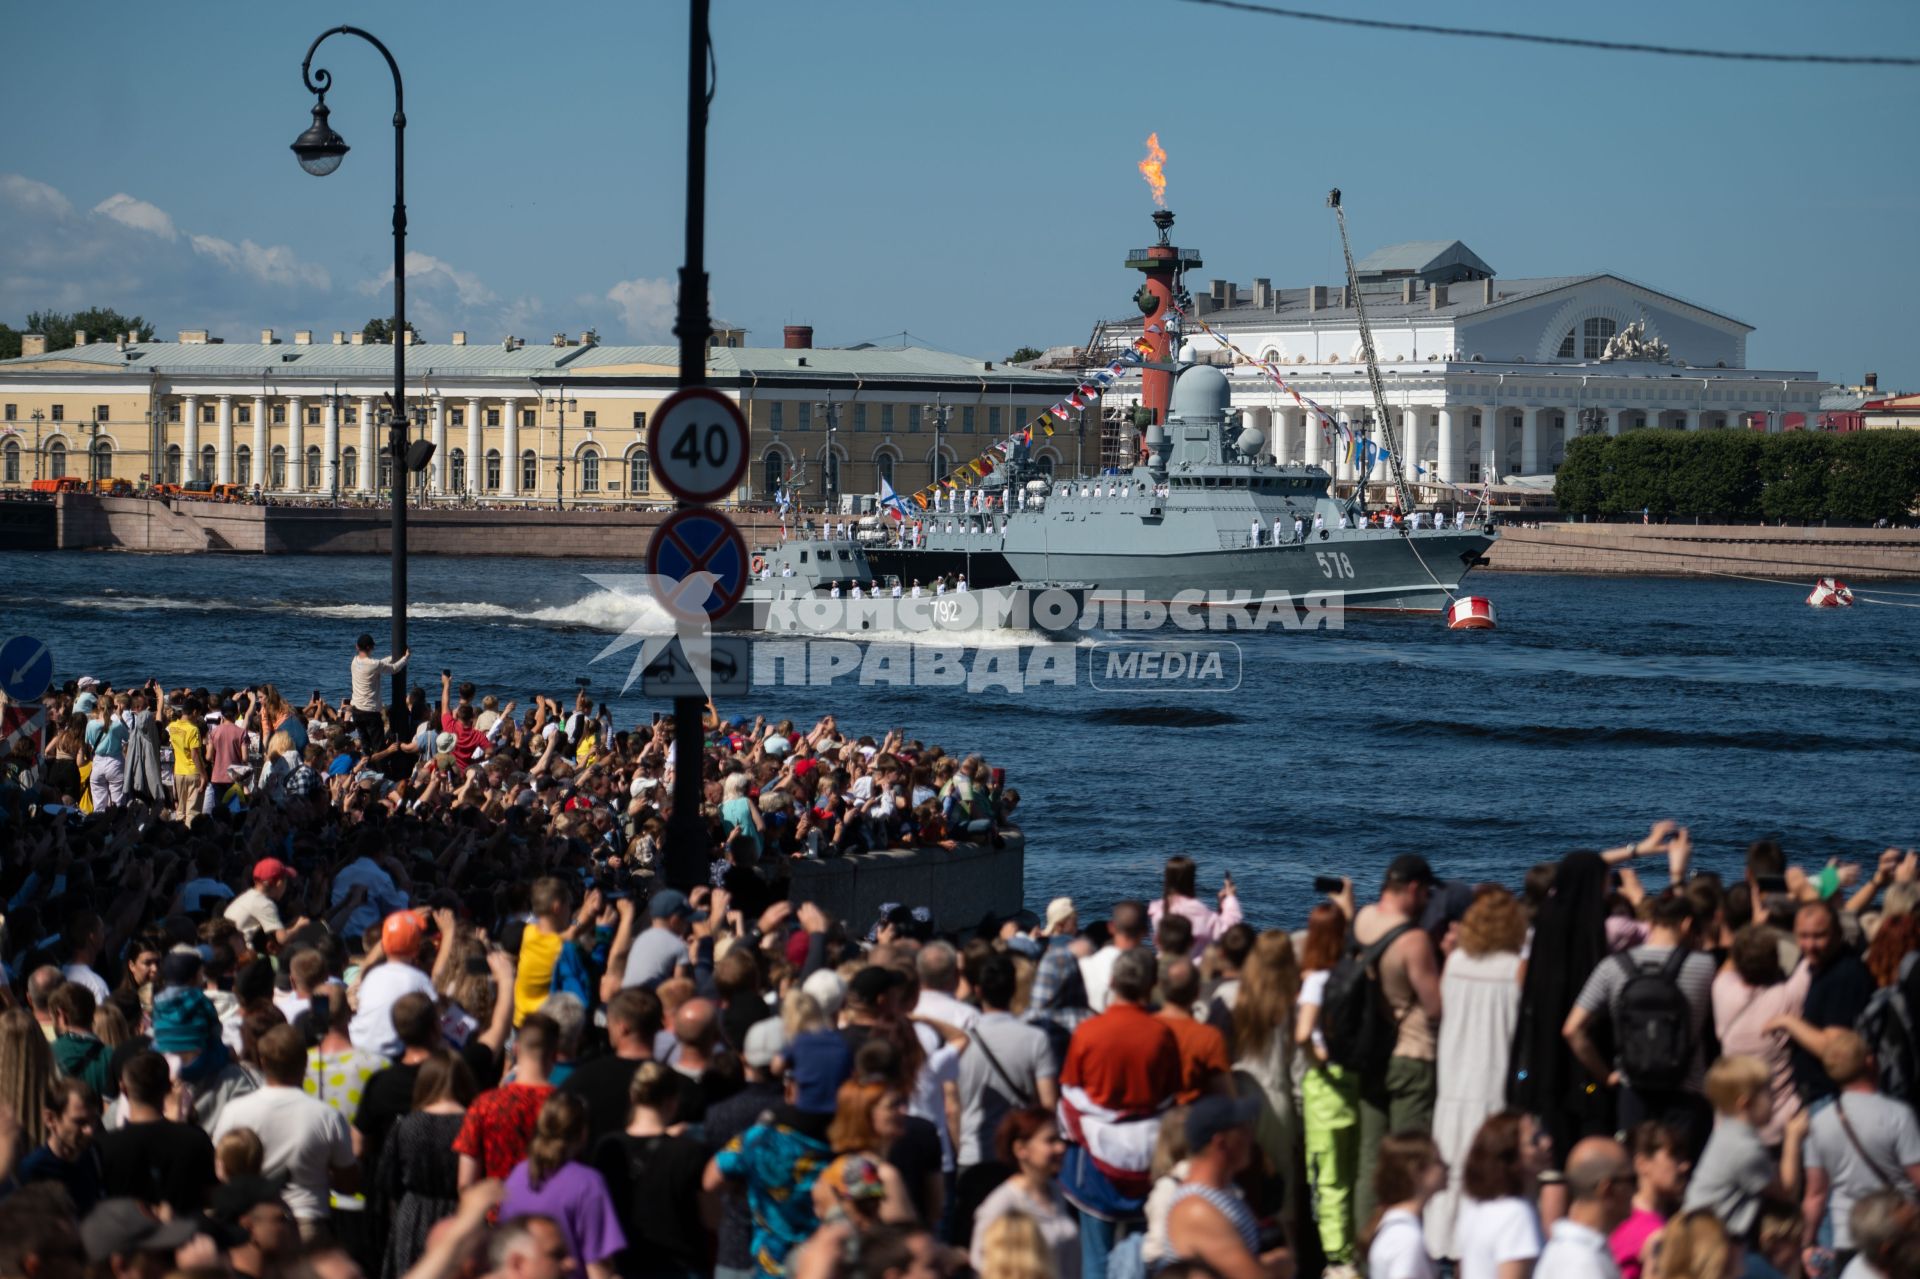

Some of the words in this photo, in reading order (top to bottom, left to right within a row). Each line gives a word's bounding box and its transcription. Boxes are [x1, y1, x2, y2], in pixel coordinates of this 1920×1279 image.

[670, 422, 729, 468] 40
[1315, 551, 1355, 579] 578
[930, 600, 960, 623] 792
